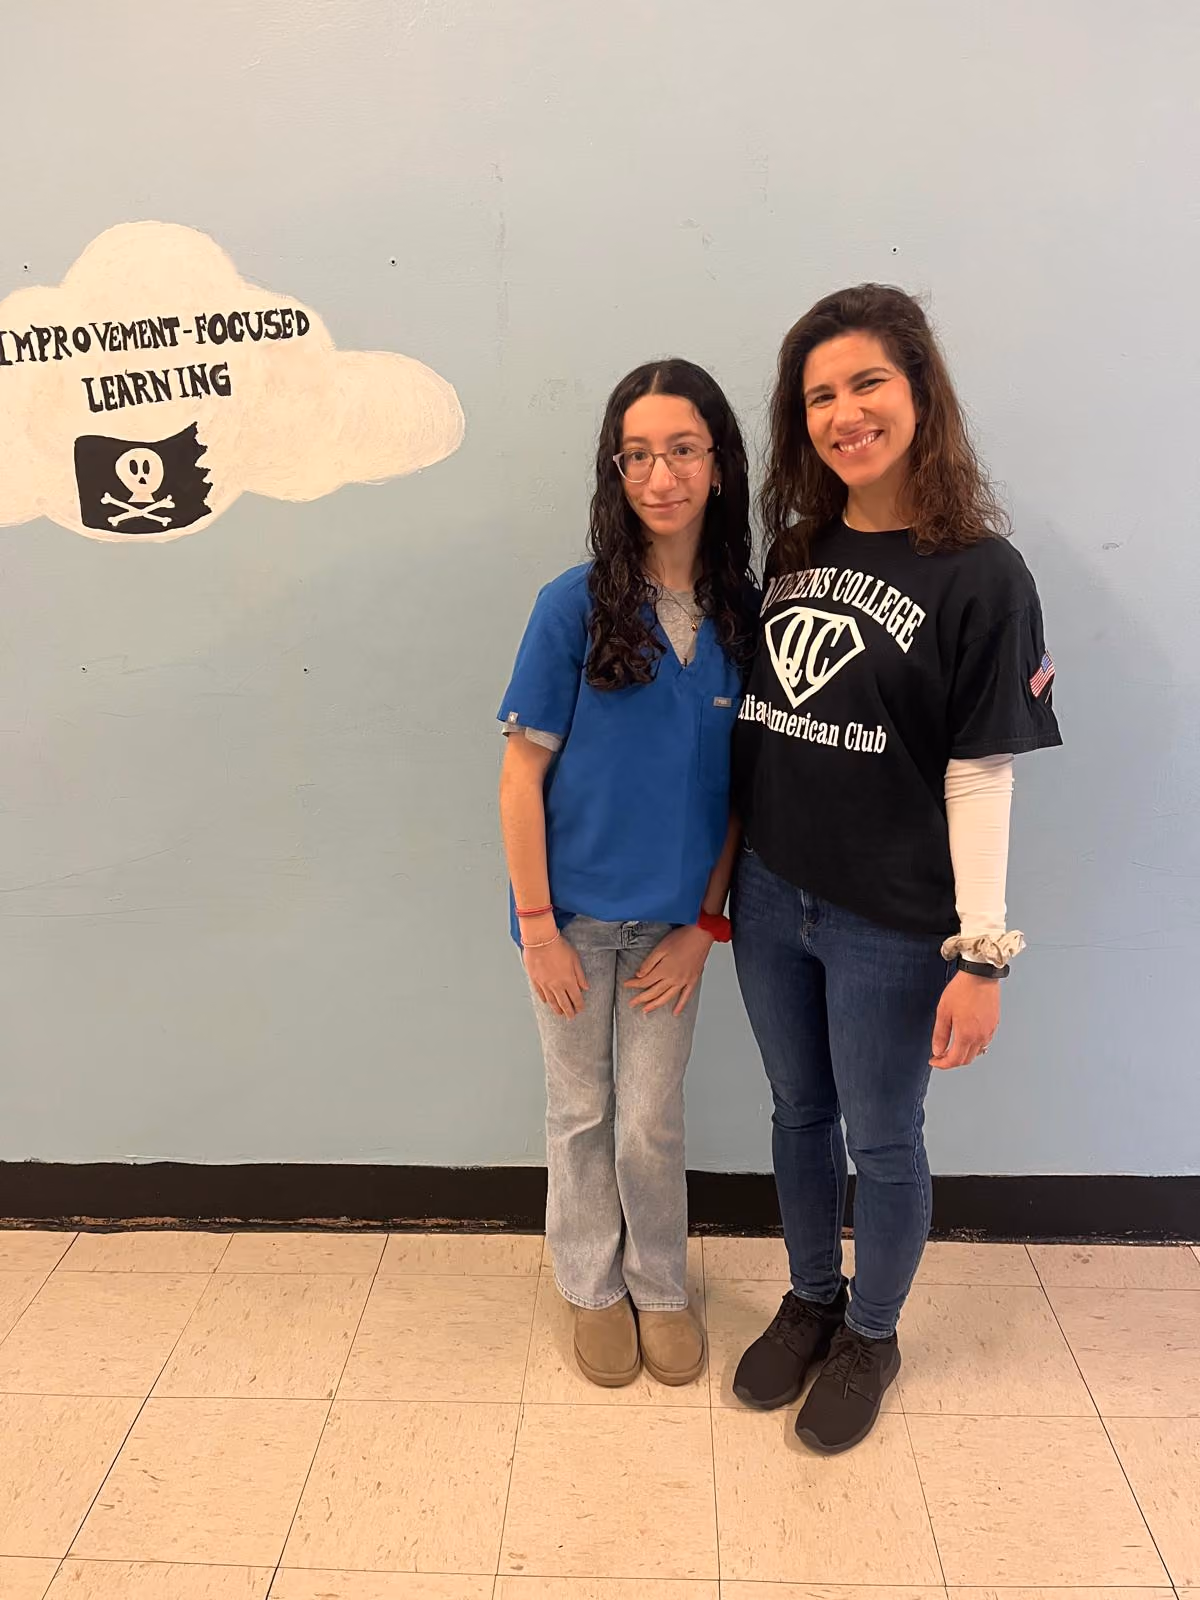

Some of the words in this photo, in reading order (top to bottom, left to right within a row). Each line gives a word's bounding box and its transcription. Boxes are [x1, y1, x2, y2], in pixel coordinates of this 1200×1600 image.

[0, 308, 310, 366] IMPROVEMENT-FOCUSED
[81, 361, 232, 413] LEARNING
[832, 568, 927, 654] COLLEGE
[778, 611, 848, 689] QC
[844, 721, 887, 754] Club
